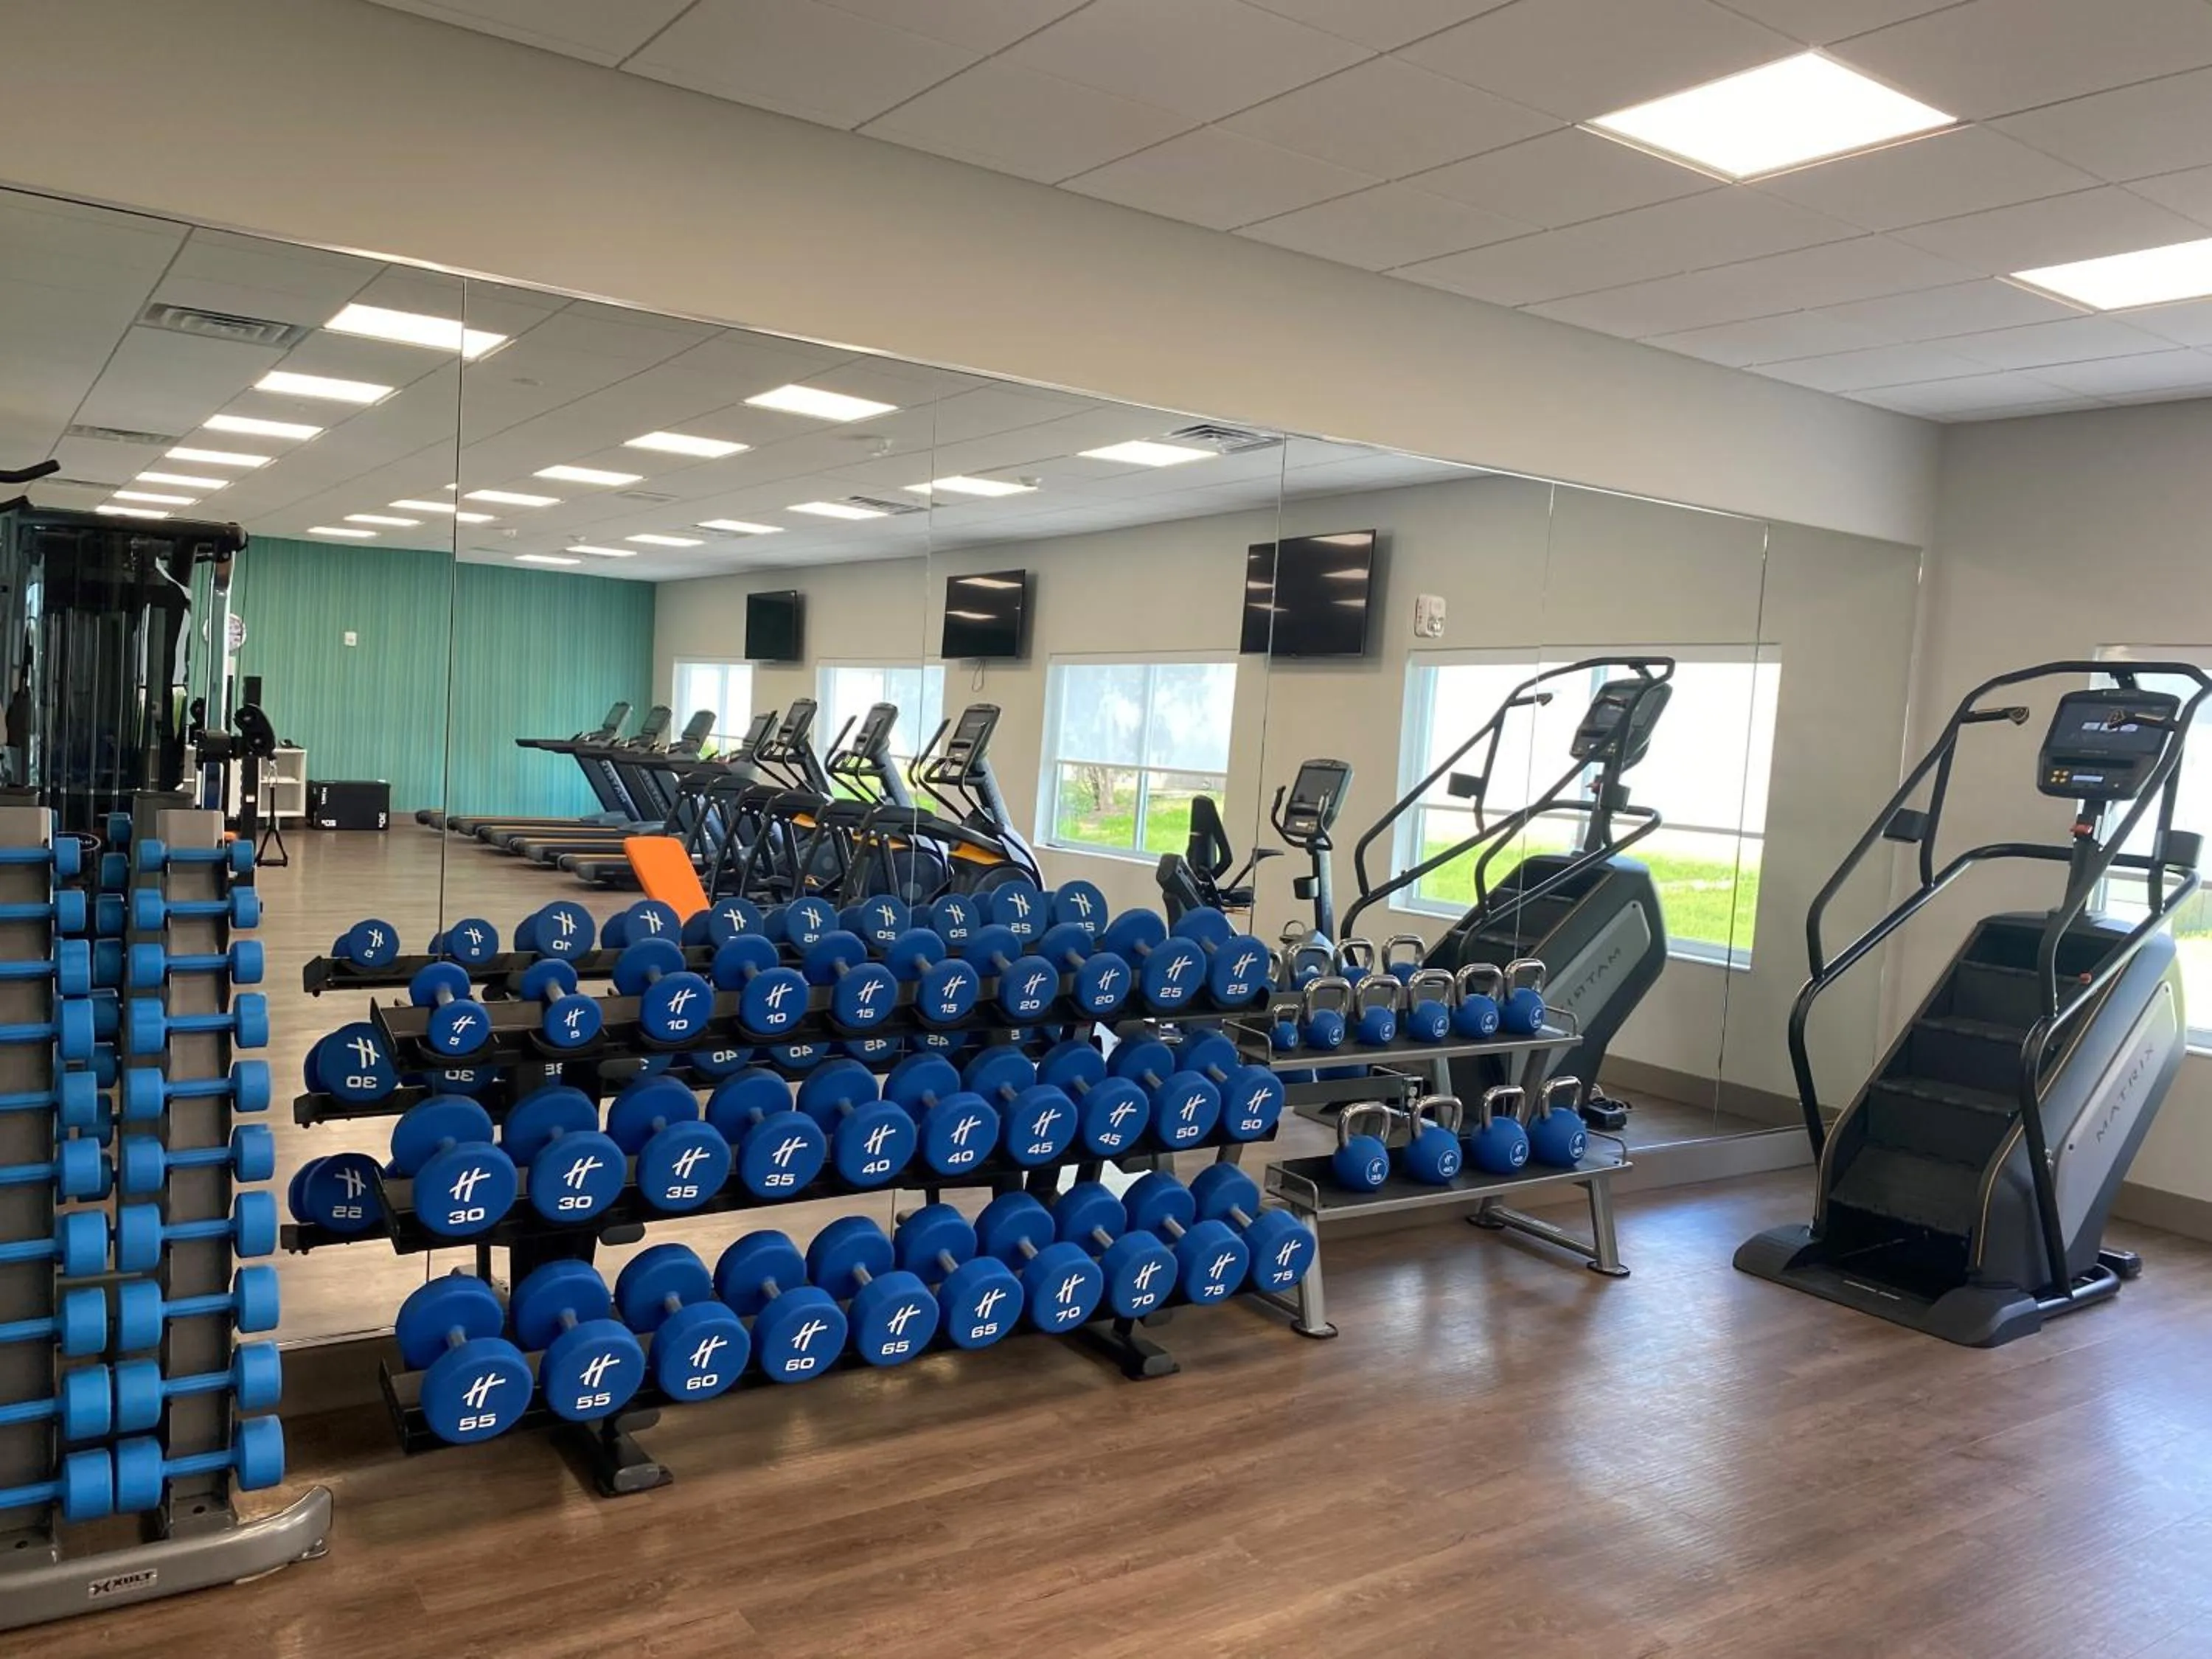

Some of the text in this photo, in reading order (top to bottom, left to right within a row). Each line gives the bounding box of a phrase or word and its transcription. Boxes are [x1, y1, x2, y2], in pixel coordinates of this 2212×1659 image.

[1159, 987, 1182, 998] 25
[1226, 983, 1248, 995] 25
[1020, 999, 1040, 1010] 20
[1095, 994, 1114, 1005] 20
[856, 1008, 874, 1018] 15
[940, 1004, 958, 1013] 15
[667, 1019, 688, 1030] 10
[766, 1012, 787, 1024] 10
[2096, 1043, 2154, 1144] MATRIX
[1241, 1119, 1262, 1130] 50
[1176, 1125, 1199, 1139] 50
[1099, 1133, 1121, 1146] 45
[1027, 1141, 1053, 1154] 45
[947, 1150, 974, 1164] 40
[862, 1159, 890, 1174] 40
[765, 1173, 795, 1186] 35
[666, 1185, 698, 1199] 35
[558, 1195, 592, 1210] 30
[448, 1207, 484, 1225] 30
[1273, 1270, 1293, 1284] 75
[1204, 1284, 1225, 1297] 75
[1132, 1293, 1155, 1308] 70
[1056, 1306, 1080, 1322] 70
[971, 1322, 998, 1338] 65
[881, 1340, 909, 1354] 65
[785, 1357, 815, 1371] 60
[686, 1374, 717, 1390] 60
[576, 1392, 611, 1409] 55
[459, 1413, 496, 1431] 55
